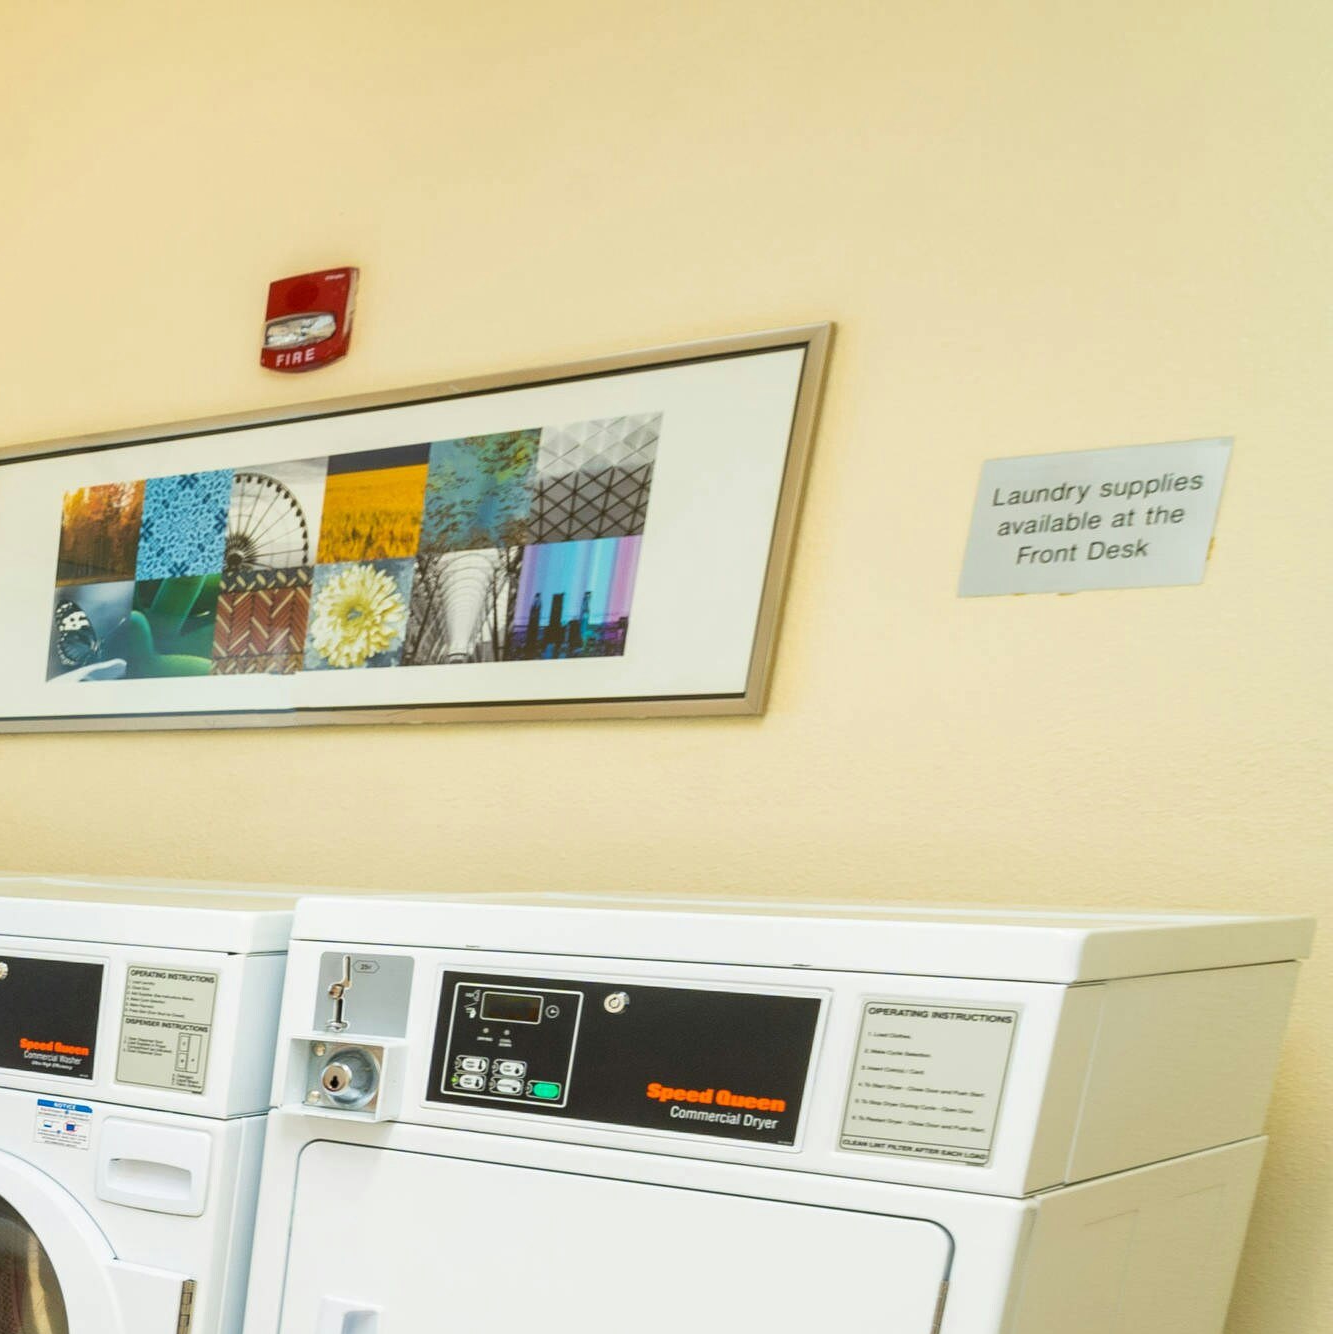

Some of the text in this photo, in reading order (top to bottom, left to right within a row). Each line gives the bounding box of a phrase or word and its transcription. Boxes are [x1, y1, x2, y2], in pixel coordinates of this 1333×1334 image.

[276, 348, 315, 366] FIRE
[992, 472, 1204, 506] Laundry supplies
[997, 506, 1184, 536] available at the
[1016, 539, 1149, 565] Front Desk
[131, 970, 214, 983] OPERATING INSTRUCTIONS
[868, 1008, 1013, 1023] OPERATING INSTRUCTIONS
[162, 1022, 208, 1032] INSTRUCTIONS
[20, 1038, 89, 1056] Speed Queen
[647, 1082, 786, 1112] Speed Queen
[670, 1106, 779, 1130] Commercial Dryer
[843, 1139, 868, 1147] CLEAN
[915, 1147, 939, 1155] AFTER
